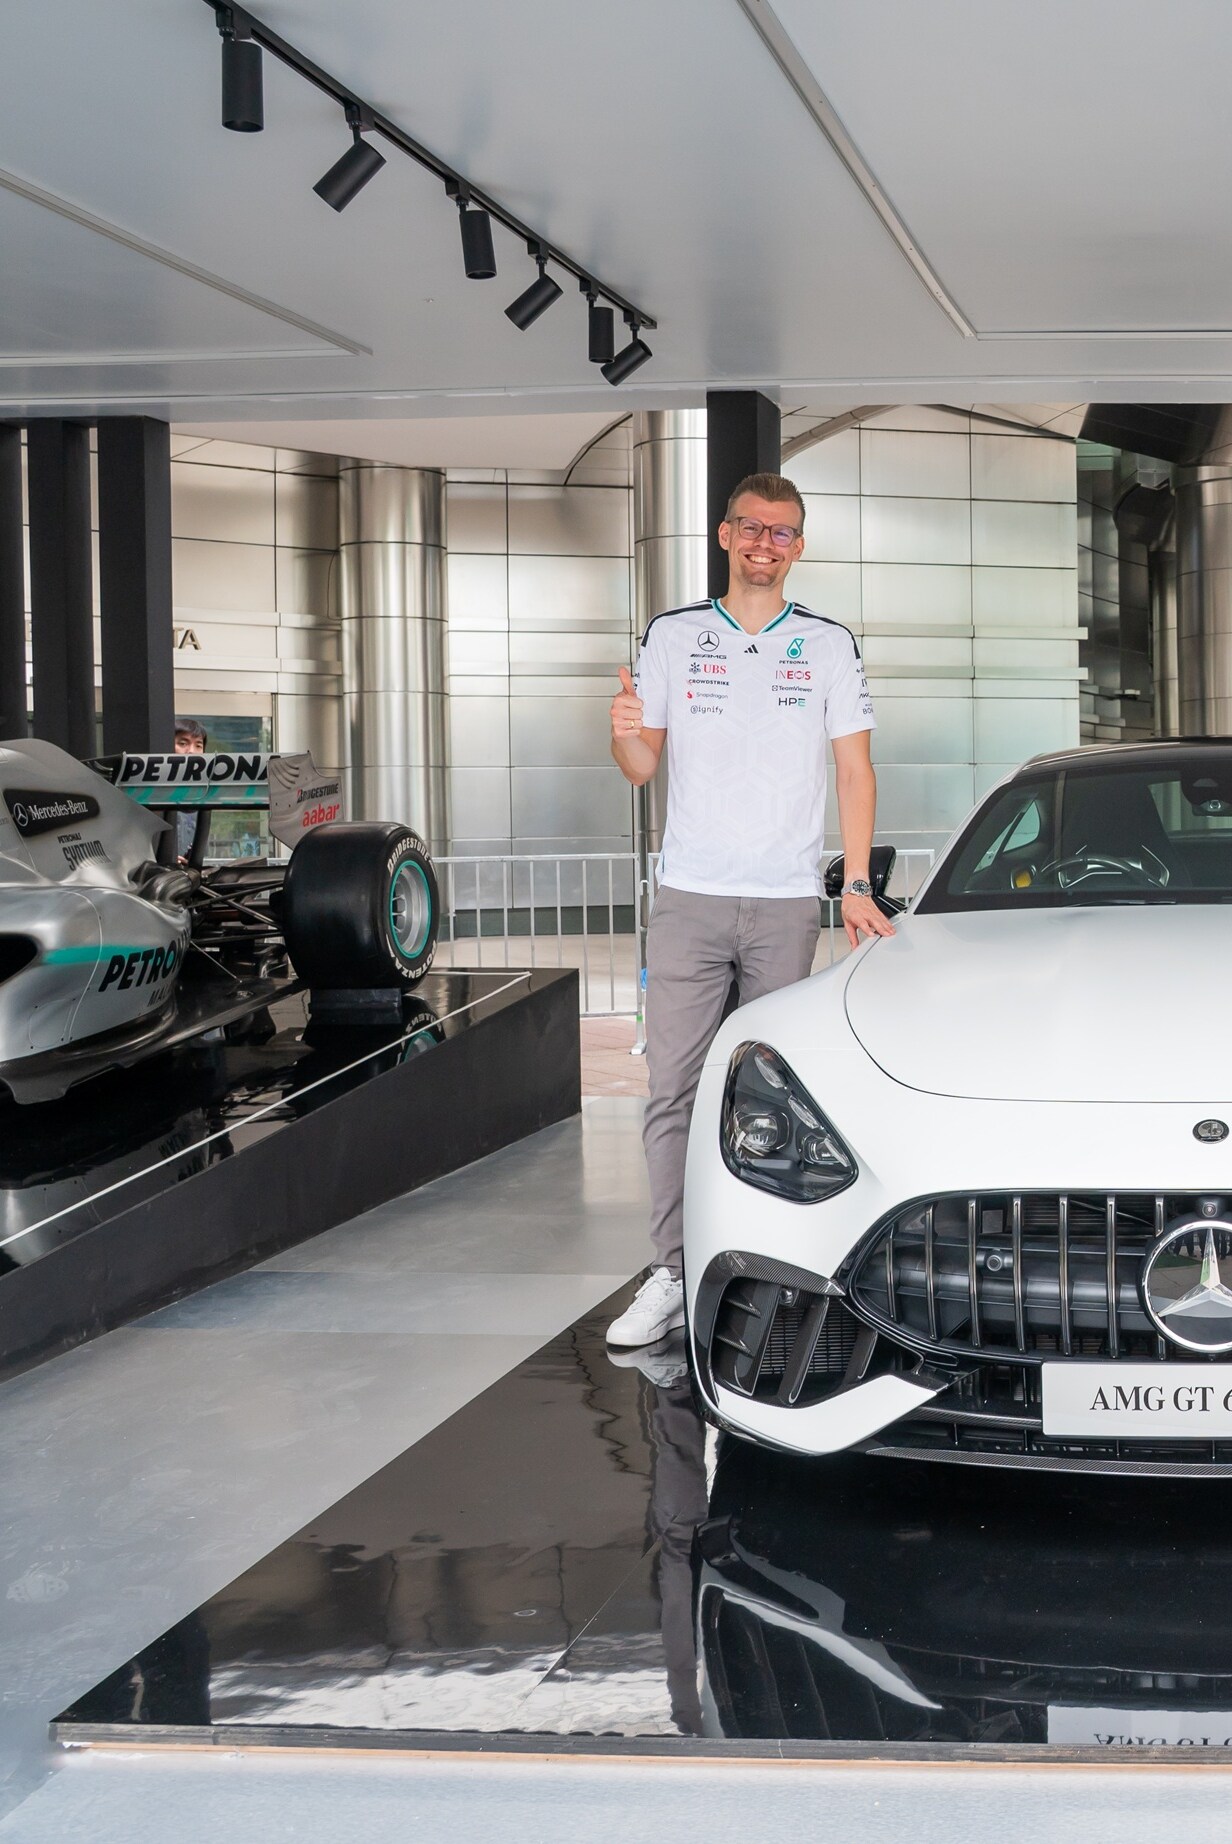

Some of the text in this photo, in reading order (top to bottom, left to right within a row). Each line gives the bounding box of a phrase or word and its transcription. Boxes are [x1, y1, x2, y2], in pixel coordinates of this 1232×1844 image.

[703, 663, 728, 674] UBS
[775, 670, 812, 681] INEOS
[696, 691, 729, 699] Snapdragon
[778, 697, 806, 707] HPE
[28, 800, 88, 820] Mercedes-Benz
[303, 804, 340, 827] aabar
[1090, 1385, 1166, 1412] AMG
[1172, 1385, 1215, 1413] GT
